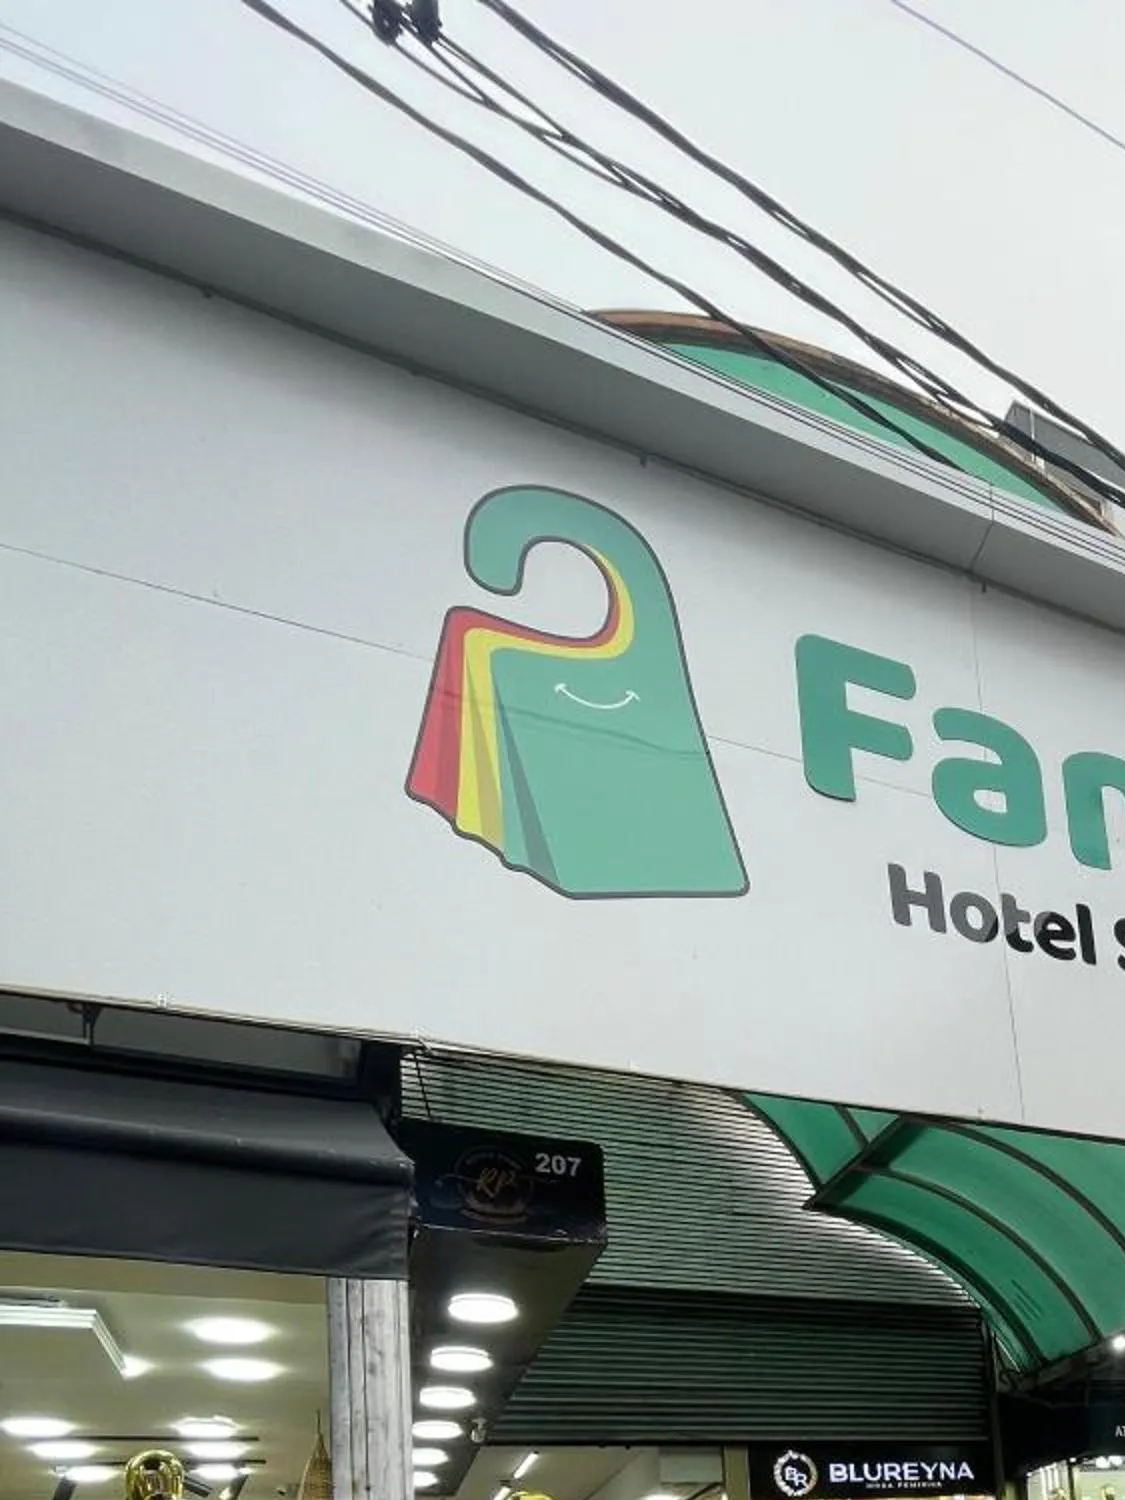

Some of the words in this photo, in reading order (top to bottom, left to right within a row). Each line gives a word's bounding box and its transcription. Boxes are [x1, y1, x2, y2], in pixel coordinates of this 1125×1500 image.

[887, 862, 1097, 965] Hotel
[534, 1152, 582, 1177] 207
[829, 1462, 975, 1483] BLUREYNA
